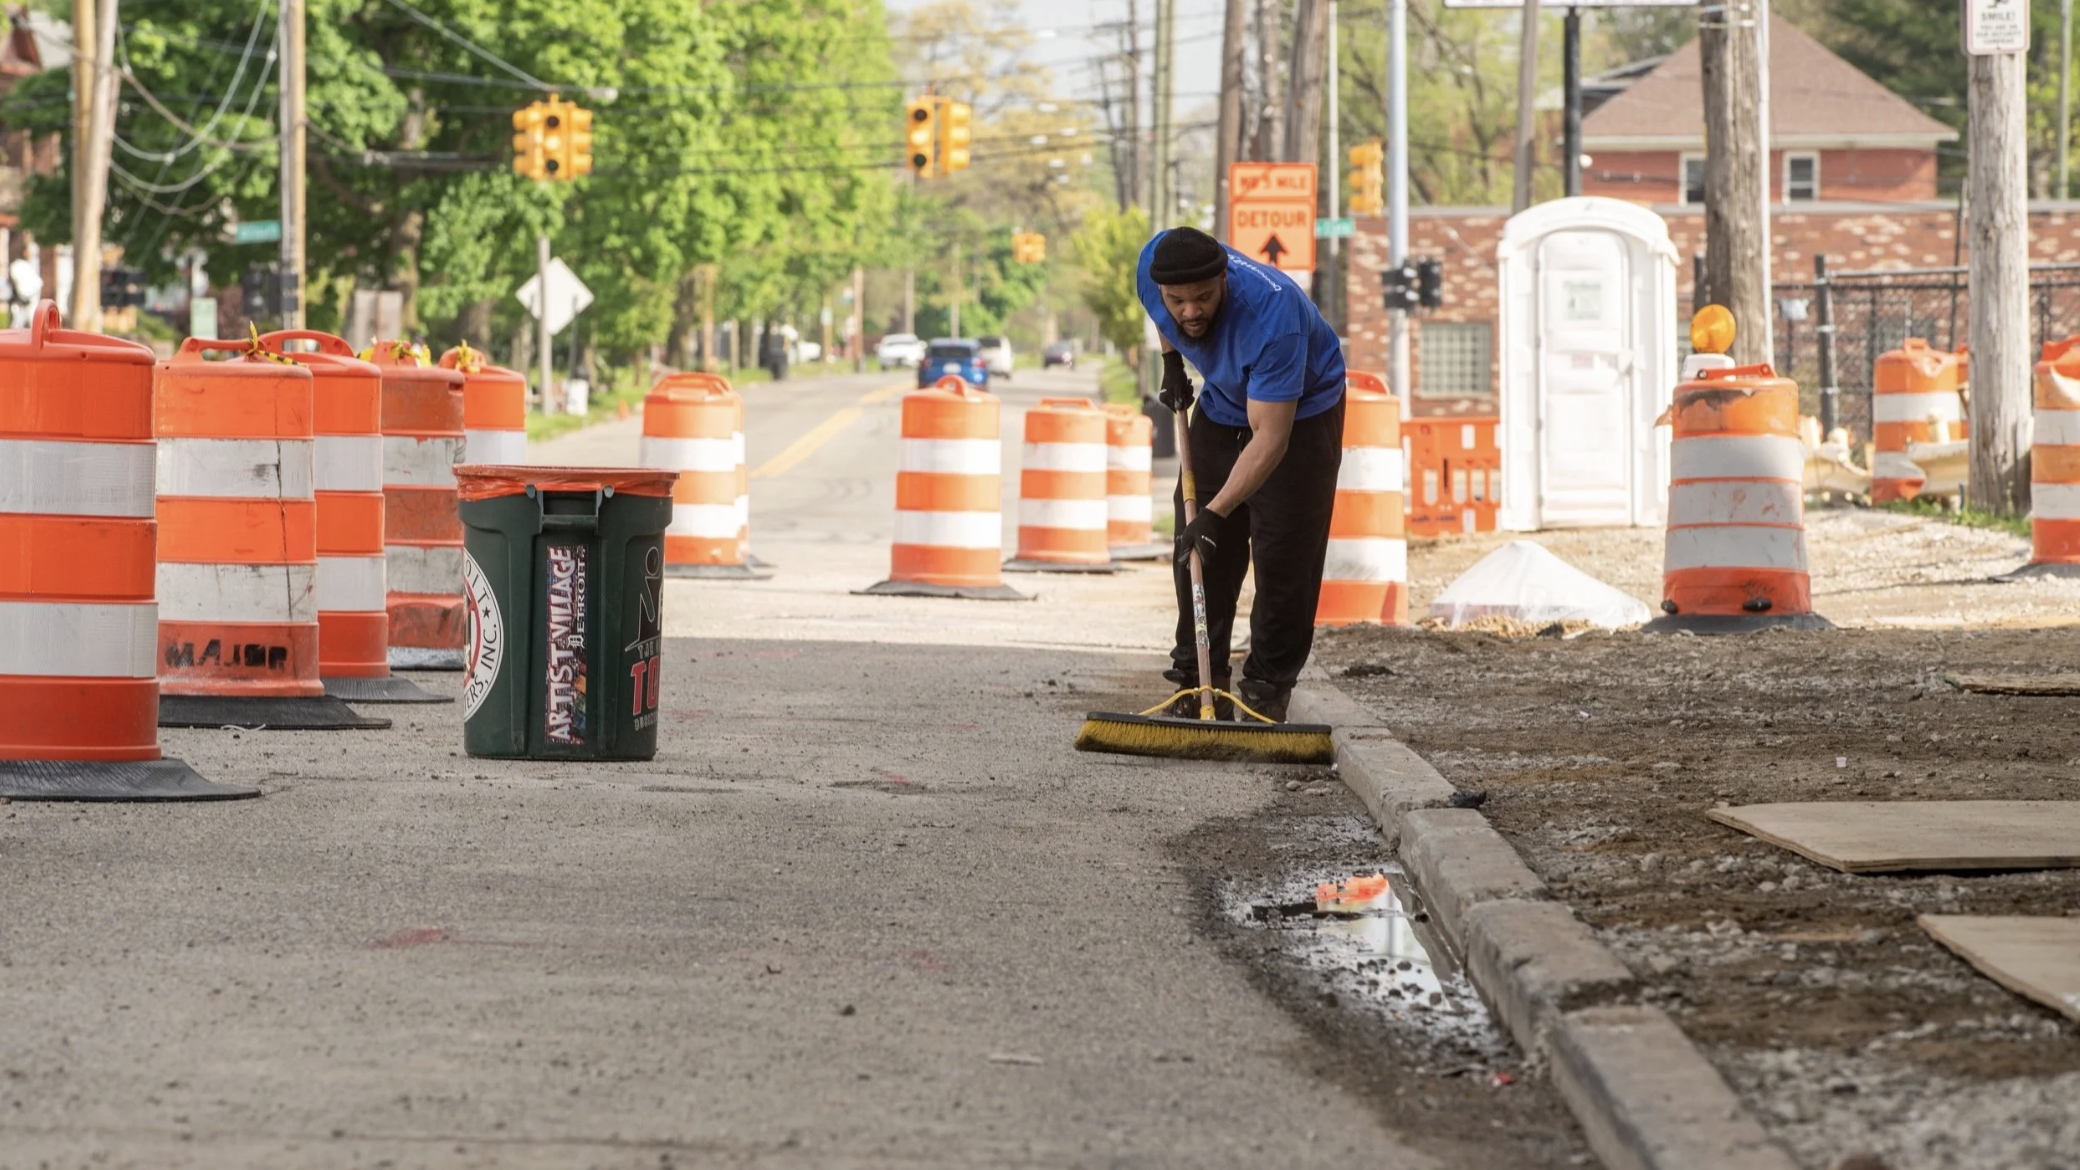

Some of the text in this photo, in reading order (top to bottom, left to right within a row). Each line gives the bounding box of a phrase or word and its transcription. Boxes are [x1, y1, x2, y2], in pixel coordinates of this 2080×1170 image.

[1276, 175, 1306, 190] MILE
[1237, 210, 1307, 228] DETOUR
[567, 560, 586, 648] DETROIT
[165, 638, 287, 672] MAJOR
[480, 623, 498, 671] INC.
[549, 546, 576, 740] ARTIST VILLAGE
